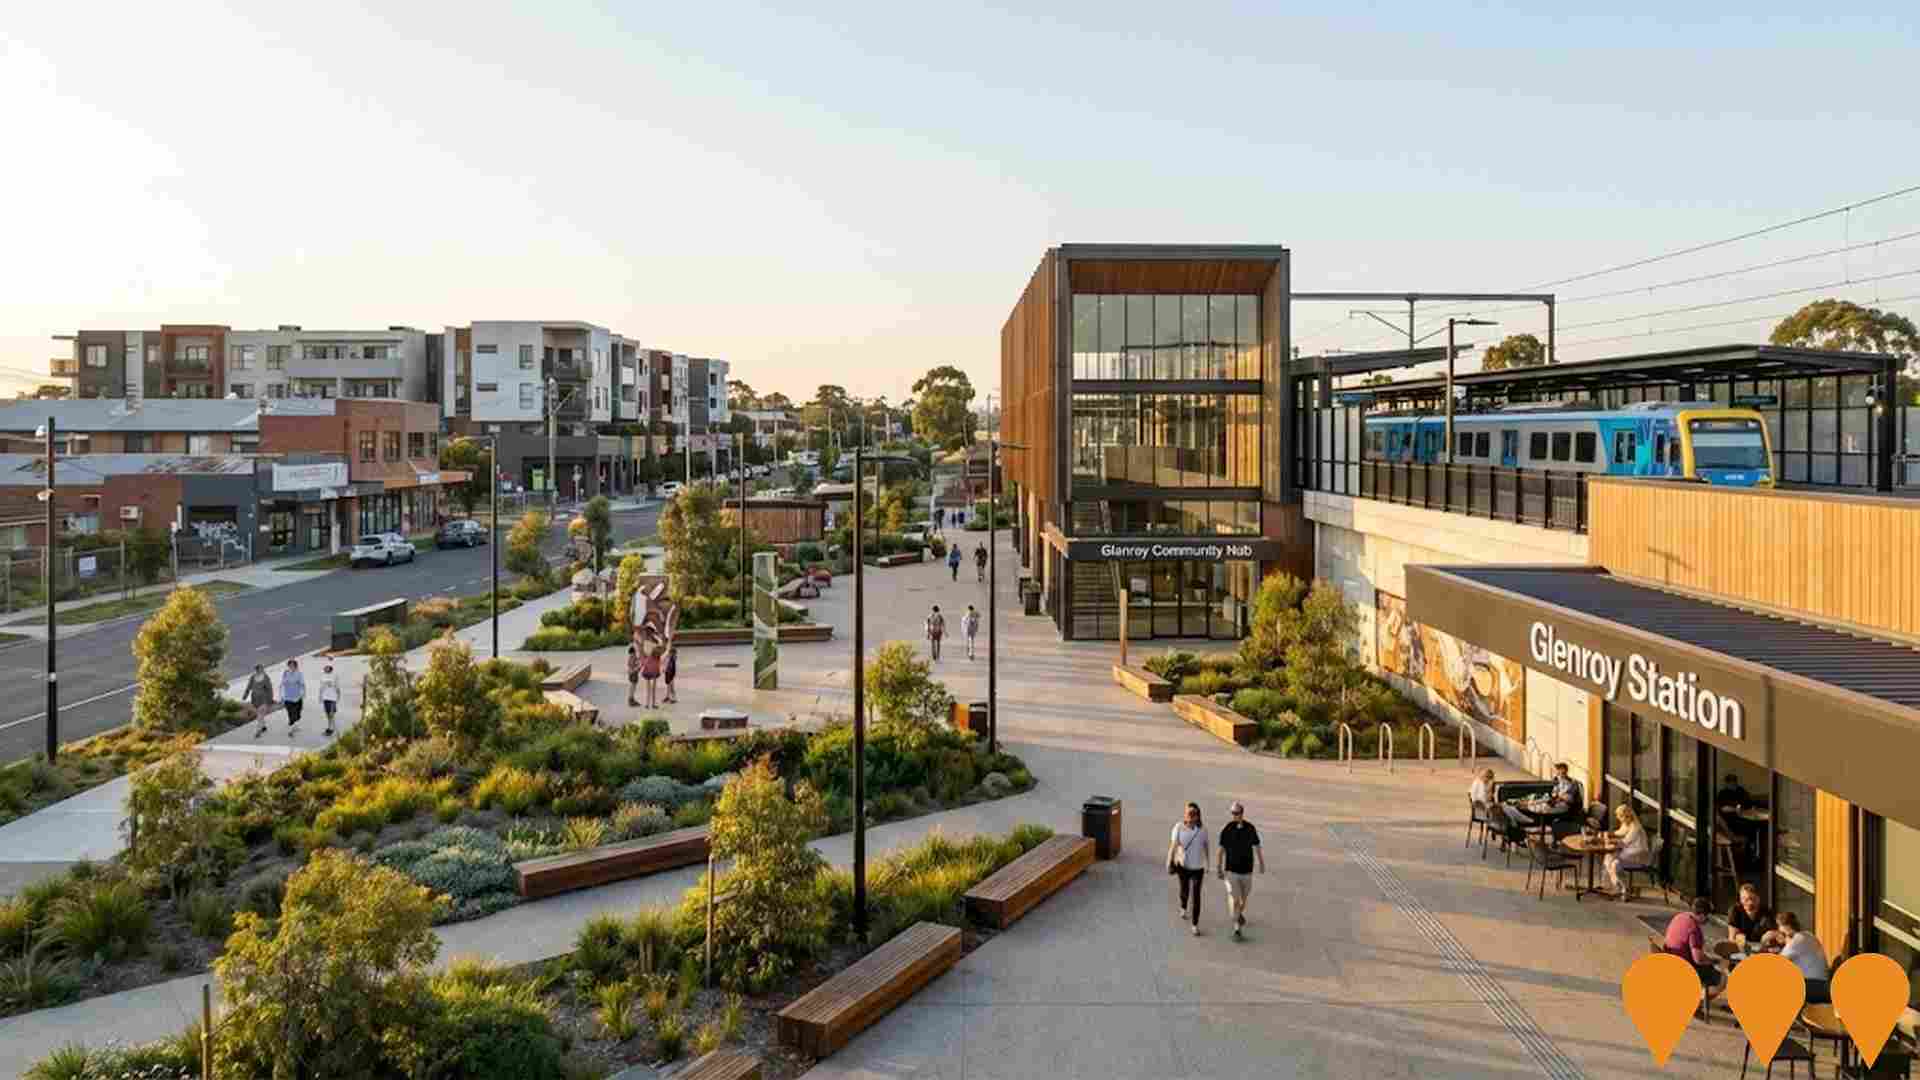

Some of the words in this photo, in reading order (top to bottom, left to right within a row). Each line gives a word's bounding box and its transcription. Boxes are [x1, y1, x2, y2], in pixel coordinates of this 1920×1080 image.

[1152, 544, 1223, 559] Community
[1530, 621, 1622, 700] Glenroy
[1627, 653, 1741, 739] Station
